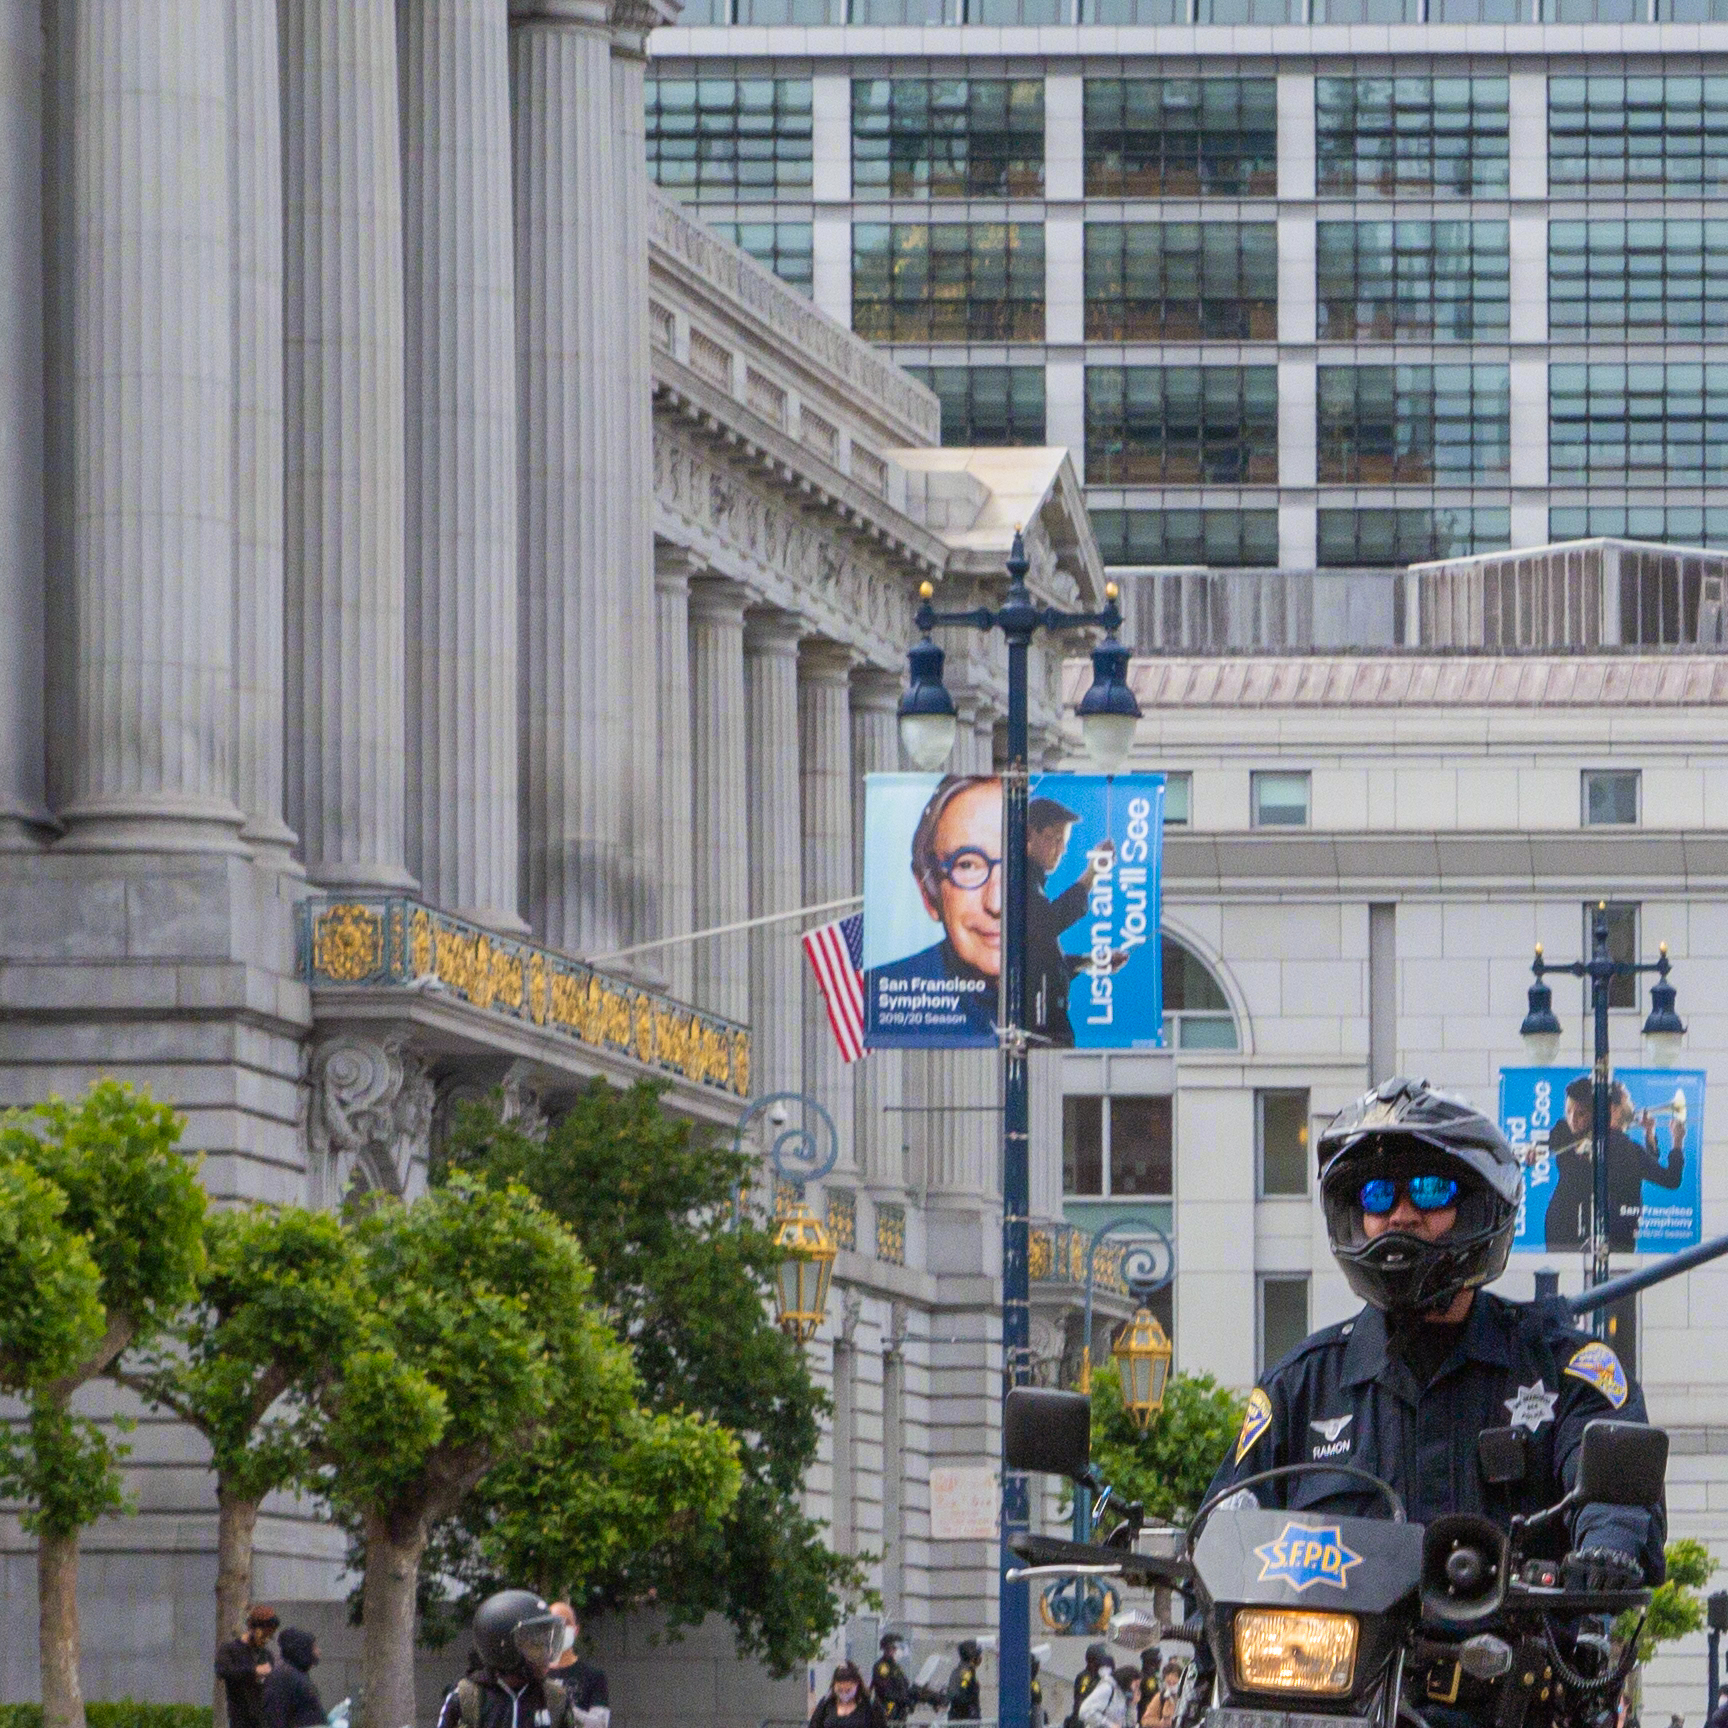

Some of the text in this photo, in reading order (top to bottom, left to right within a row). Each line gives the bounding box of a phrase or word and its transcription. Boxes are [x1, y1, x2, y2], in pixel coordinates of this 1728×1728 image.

[1119, 797, 1150, 952] You'll See
[1086, 850, 1114, 1026] Listen and
[879, 975, 987, 993] San Francisco
[879, 992, 960, 1012] Symphony
[924, 1012, 967, 1025] Season
[1531, 1080, 1552, 1128] See
[1620, 1203, 1694, 1217] San Francisco
[1637, 1215, 1694, 1230] Symphony
[1312, 1438, 1351, 1461] RAMON
[1269, 1540, 1342, 1575] S.F.P.D.
